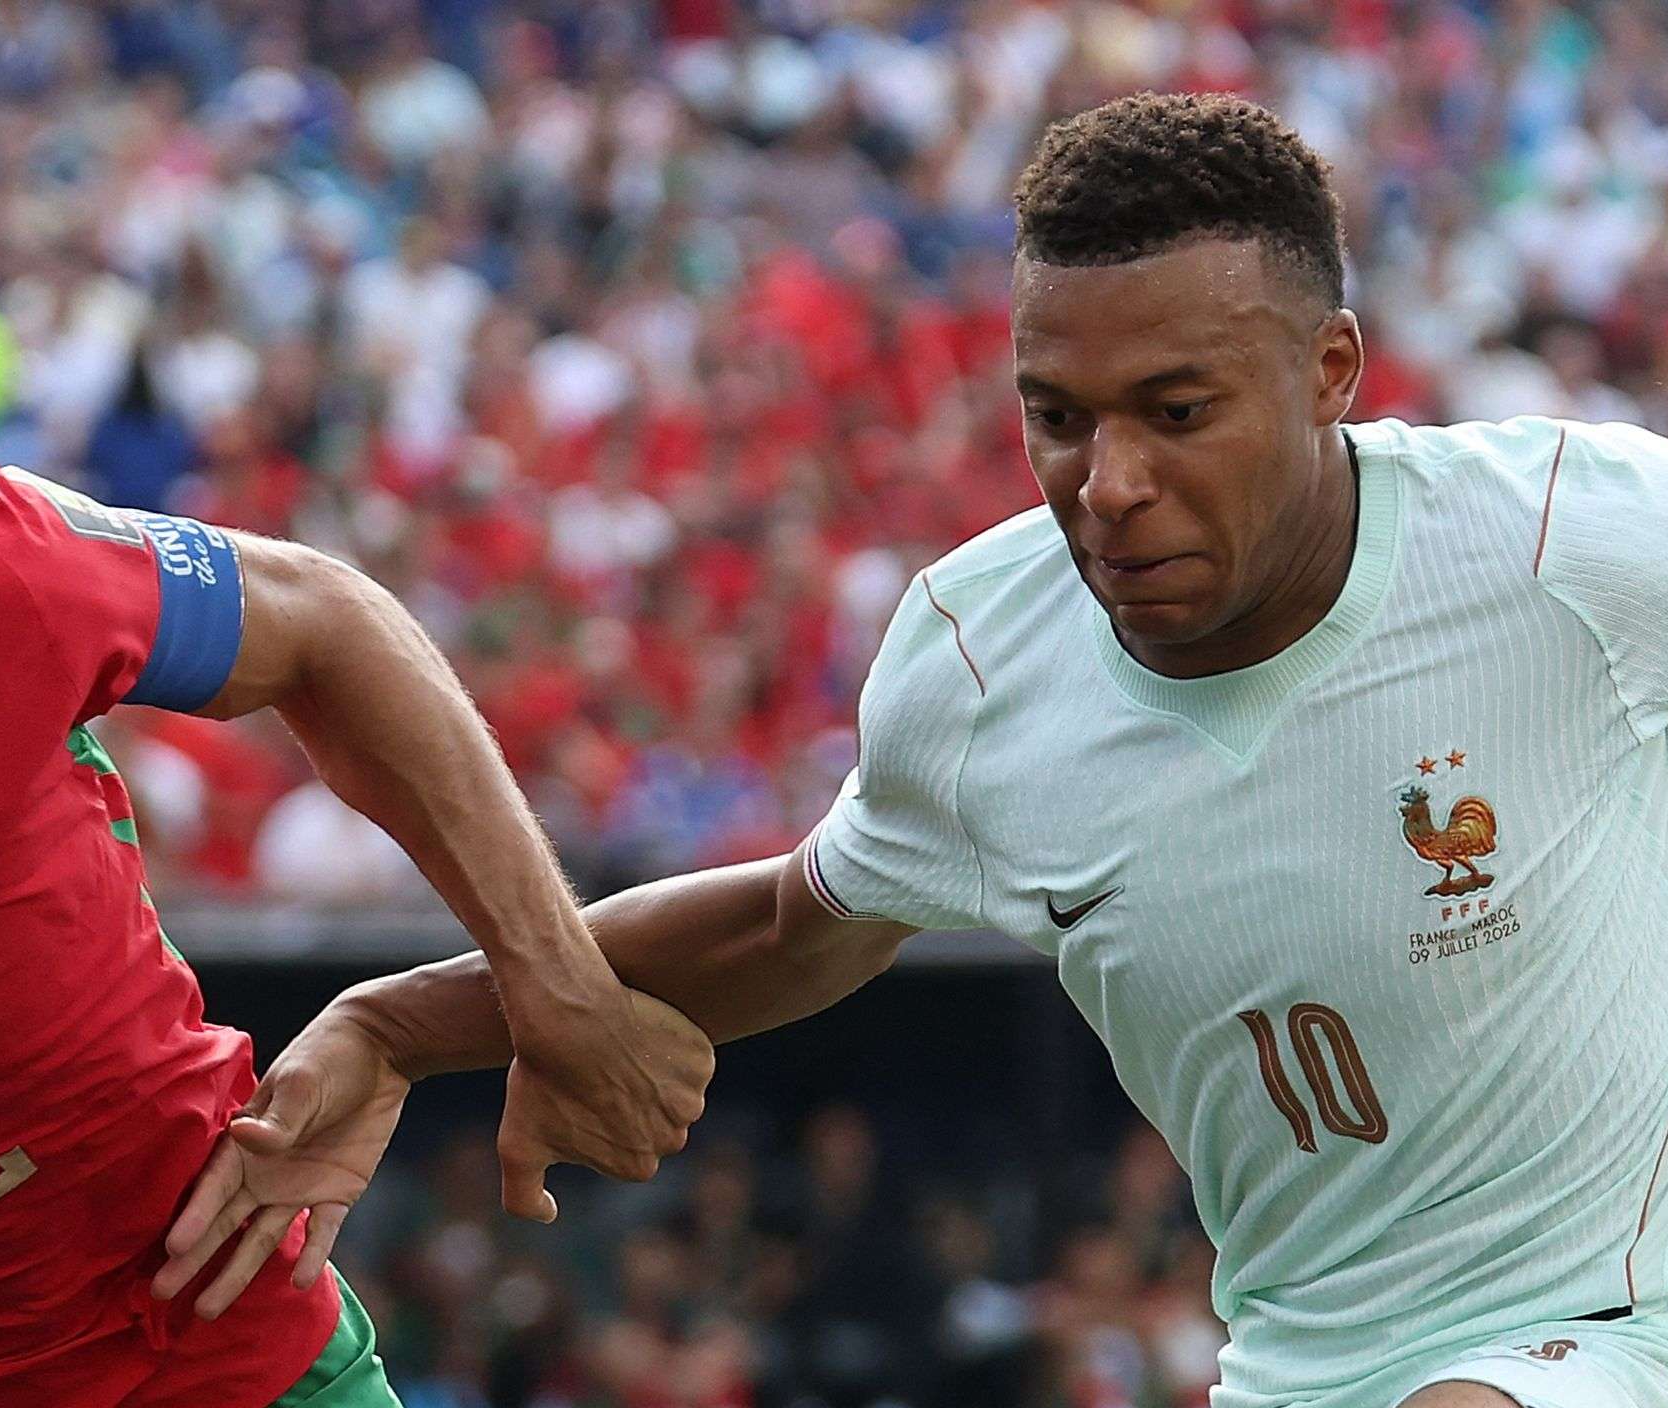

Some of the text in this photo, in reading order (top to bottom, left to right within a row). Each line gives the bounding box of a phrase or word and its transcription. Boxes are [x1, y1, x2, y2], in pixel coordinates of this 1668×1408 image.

[1409, 904, 1516, 948] FRANCE MAROC
[1409, 919, 1521, 965] 09 JUILLET 2026
[1236, 1002, 1389, 1154] 10
